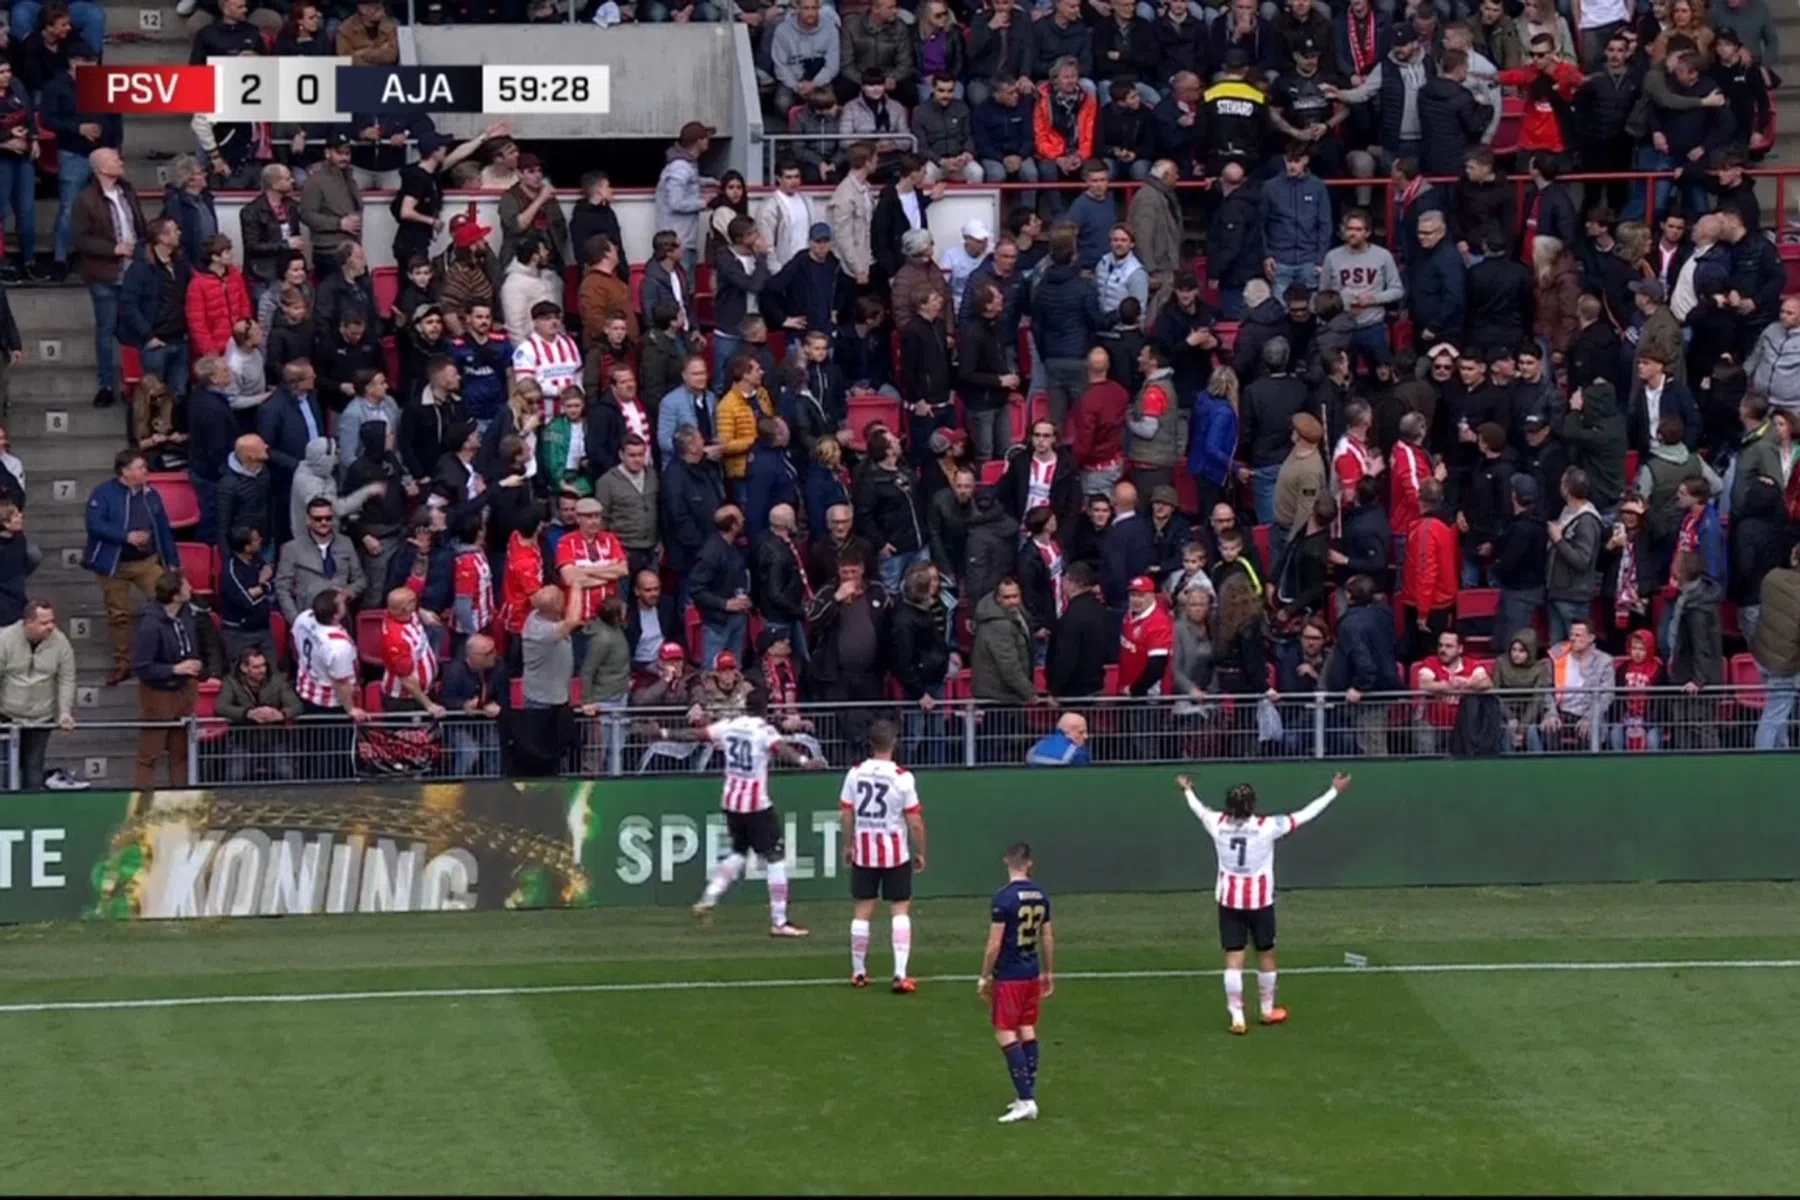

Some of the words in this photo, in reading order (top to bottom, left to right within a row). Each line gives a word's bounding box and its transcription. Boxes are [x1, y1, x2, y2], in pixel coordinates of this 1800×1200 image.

[143, 14, 158, 26] 12
[1340, 267, 1377, 286] PSV
[46, 345, 55, 356] 9
[53, 416, 61, 428] 8
[61, 485, 68, 496] 7
[77, 622, 86, 635] 5
[83, 692, 92, 703] 4
[725, 736, 753, 771] 30
[92, 762, 100, 774] 3
[857, 781, 889, 819] 23
[1230, 837, 1247, 866] 7
[0, 828, 65, 888] TE
